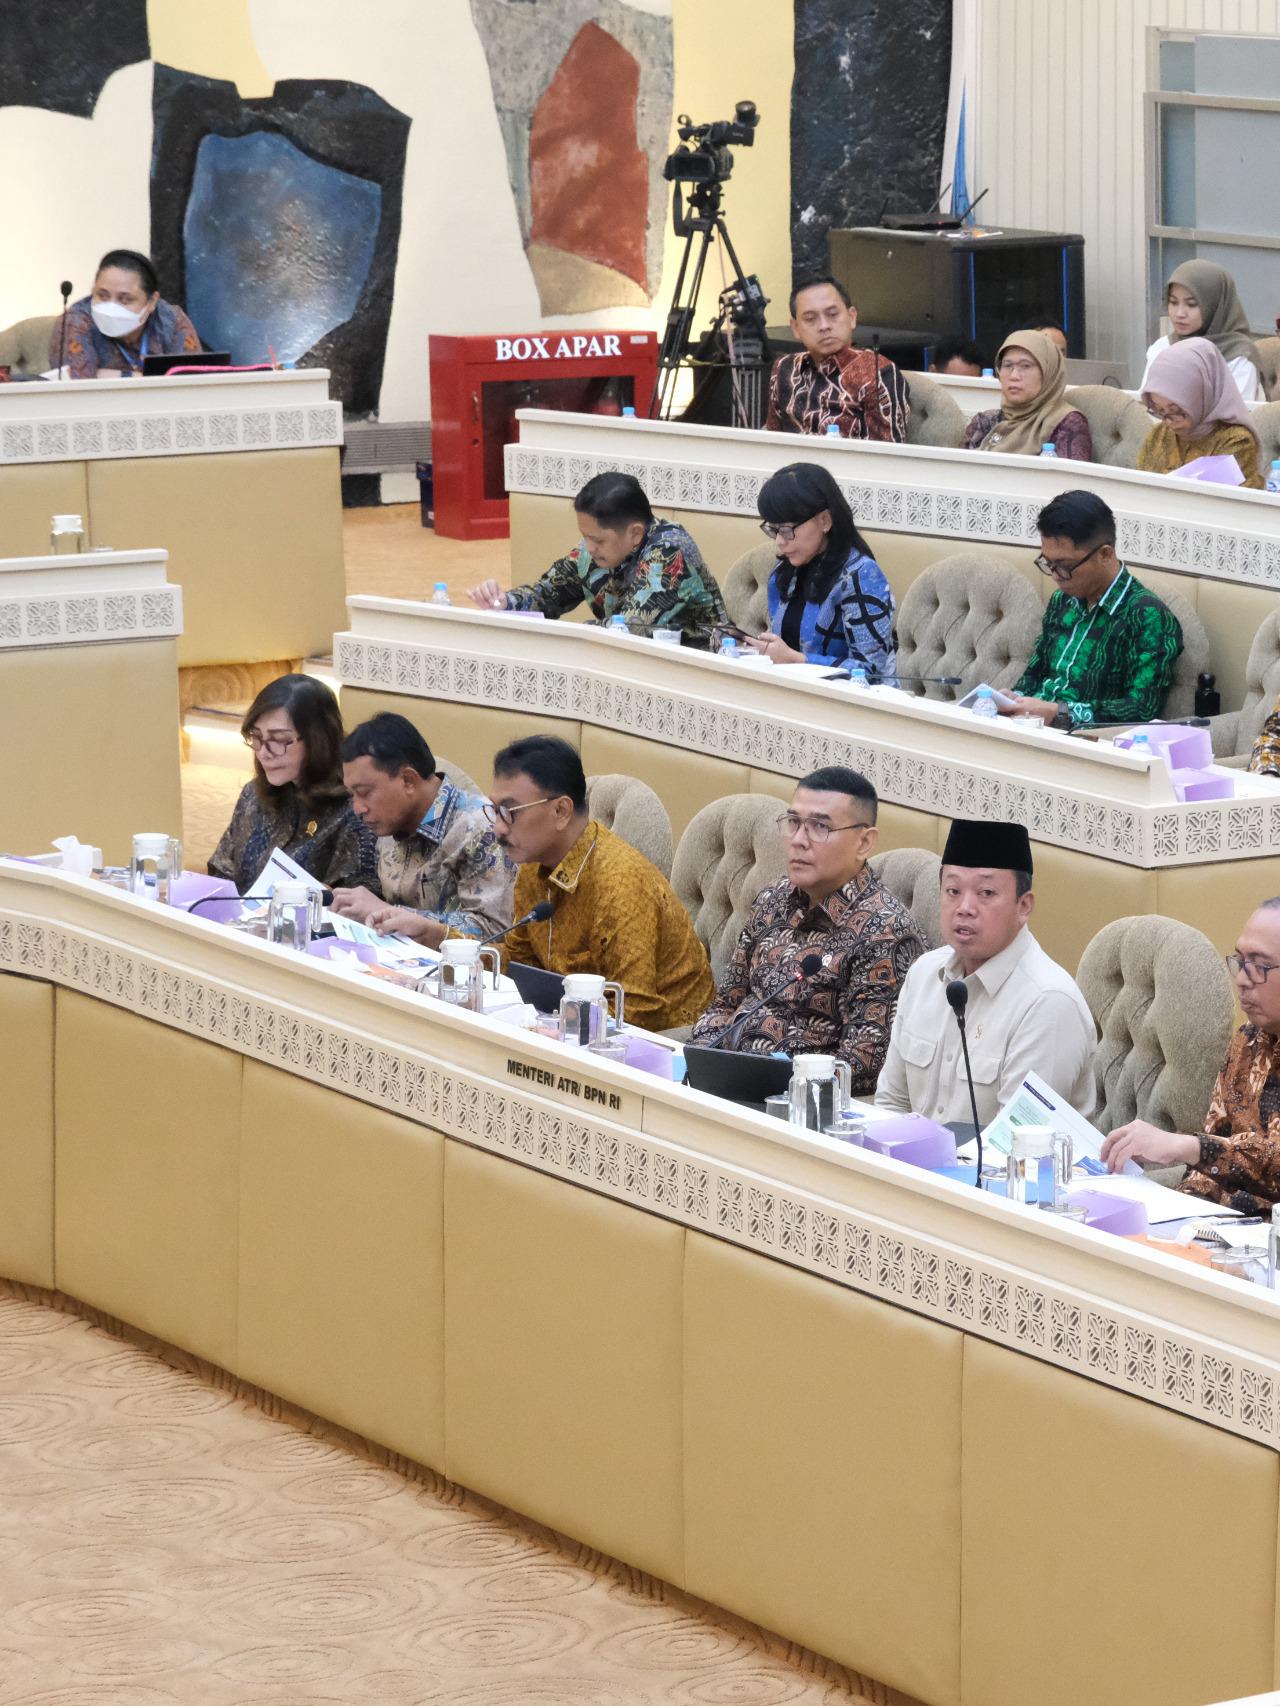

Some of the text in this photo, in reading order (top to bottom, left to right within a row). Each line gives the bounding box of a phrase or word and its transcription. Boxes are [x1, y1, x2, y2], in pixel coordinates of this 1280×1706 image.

[496, 338, 550, 360] BOX
[555, 335, 622, 357] APAR
[507, 1060, 554, 1087] MENTERI
[584, 1085, 606, 1106] BPN
[609, 1093, 621, 1110] RI
